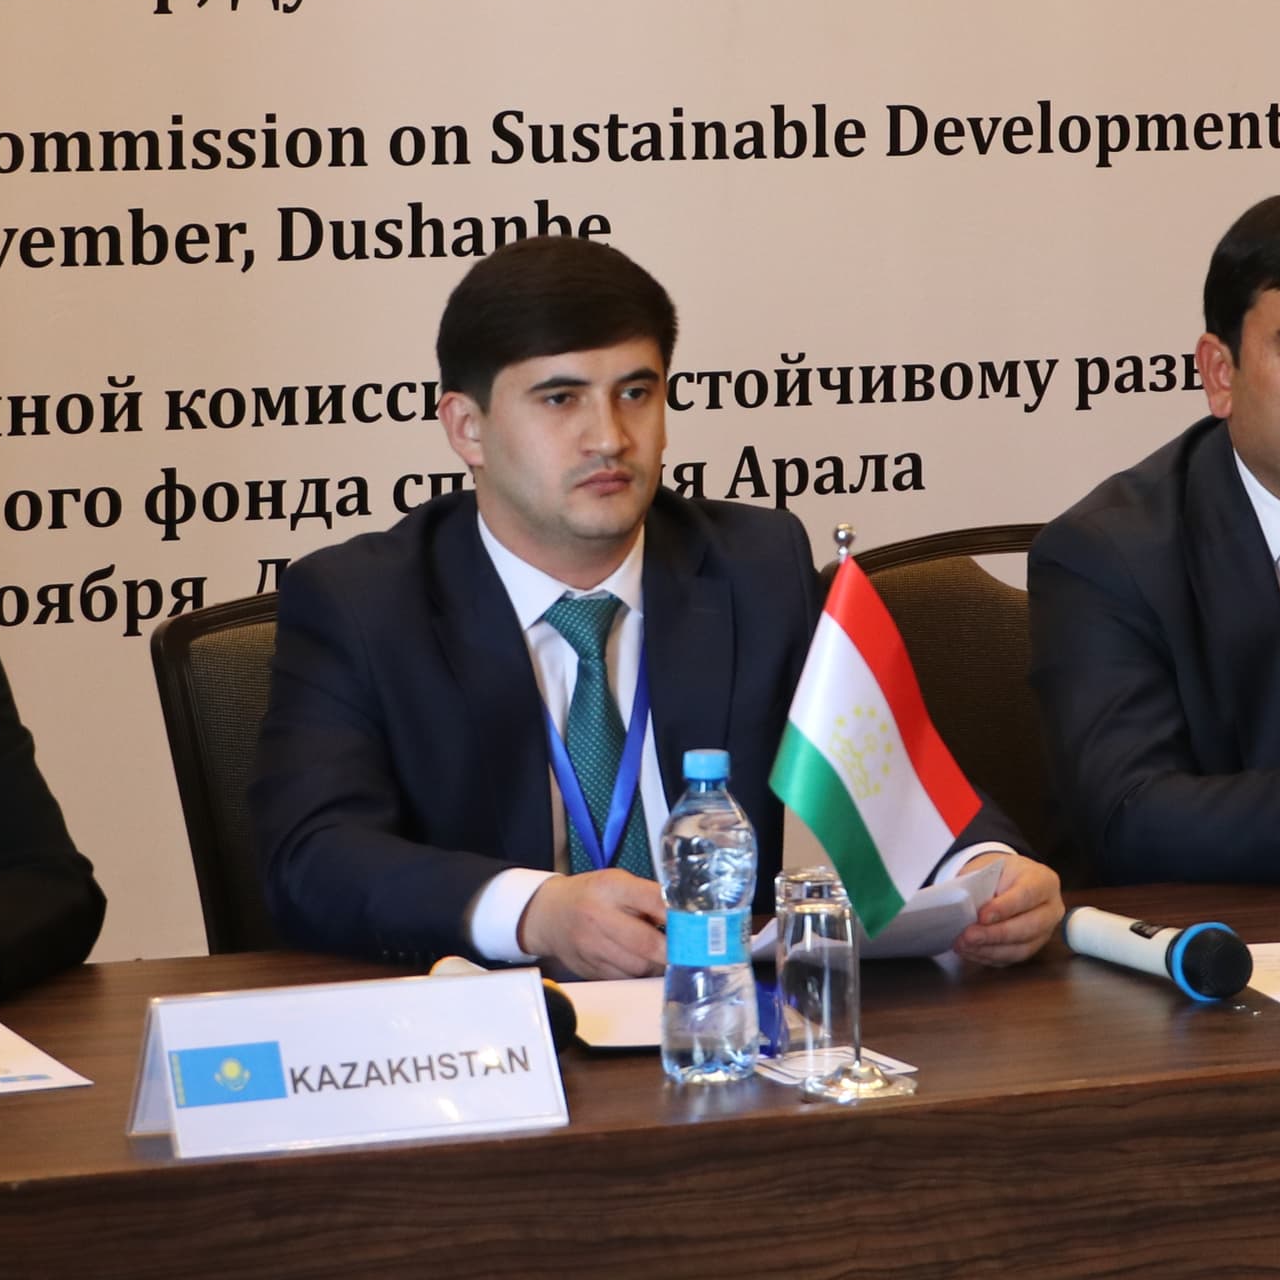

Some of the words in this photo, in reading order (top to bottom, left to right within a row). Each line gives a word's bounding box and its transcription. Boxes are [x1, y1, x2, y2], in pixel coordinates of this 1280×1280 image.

[389, 125, 471, 167] on
[491, 103, 867, 166] Sustainable
[276, 199, 612, 263] Dushanbe
[163, 380, 440, 431] комисс
[666, 352, 1060, 414] стойчивому
[1074, 353, 1205, 411] разв
[144, 467, 373, 542] фонда
[723, 445, 926, 511] Арала
[290, 1047, 530, 1094] KAZAKHSTAN
